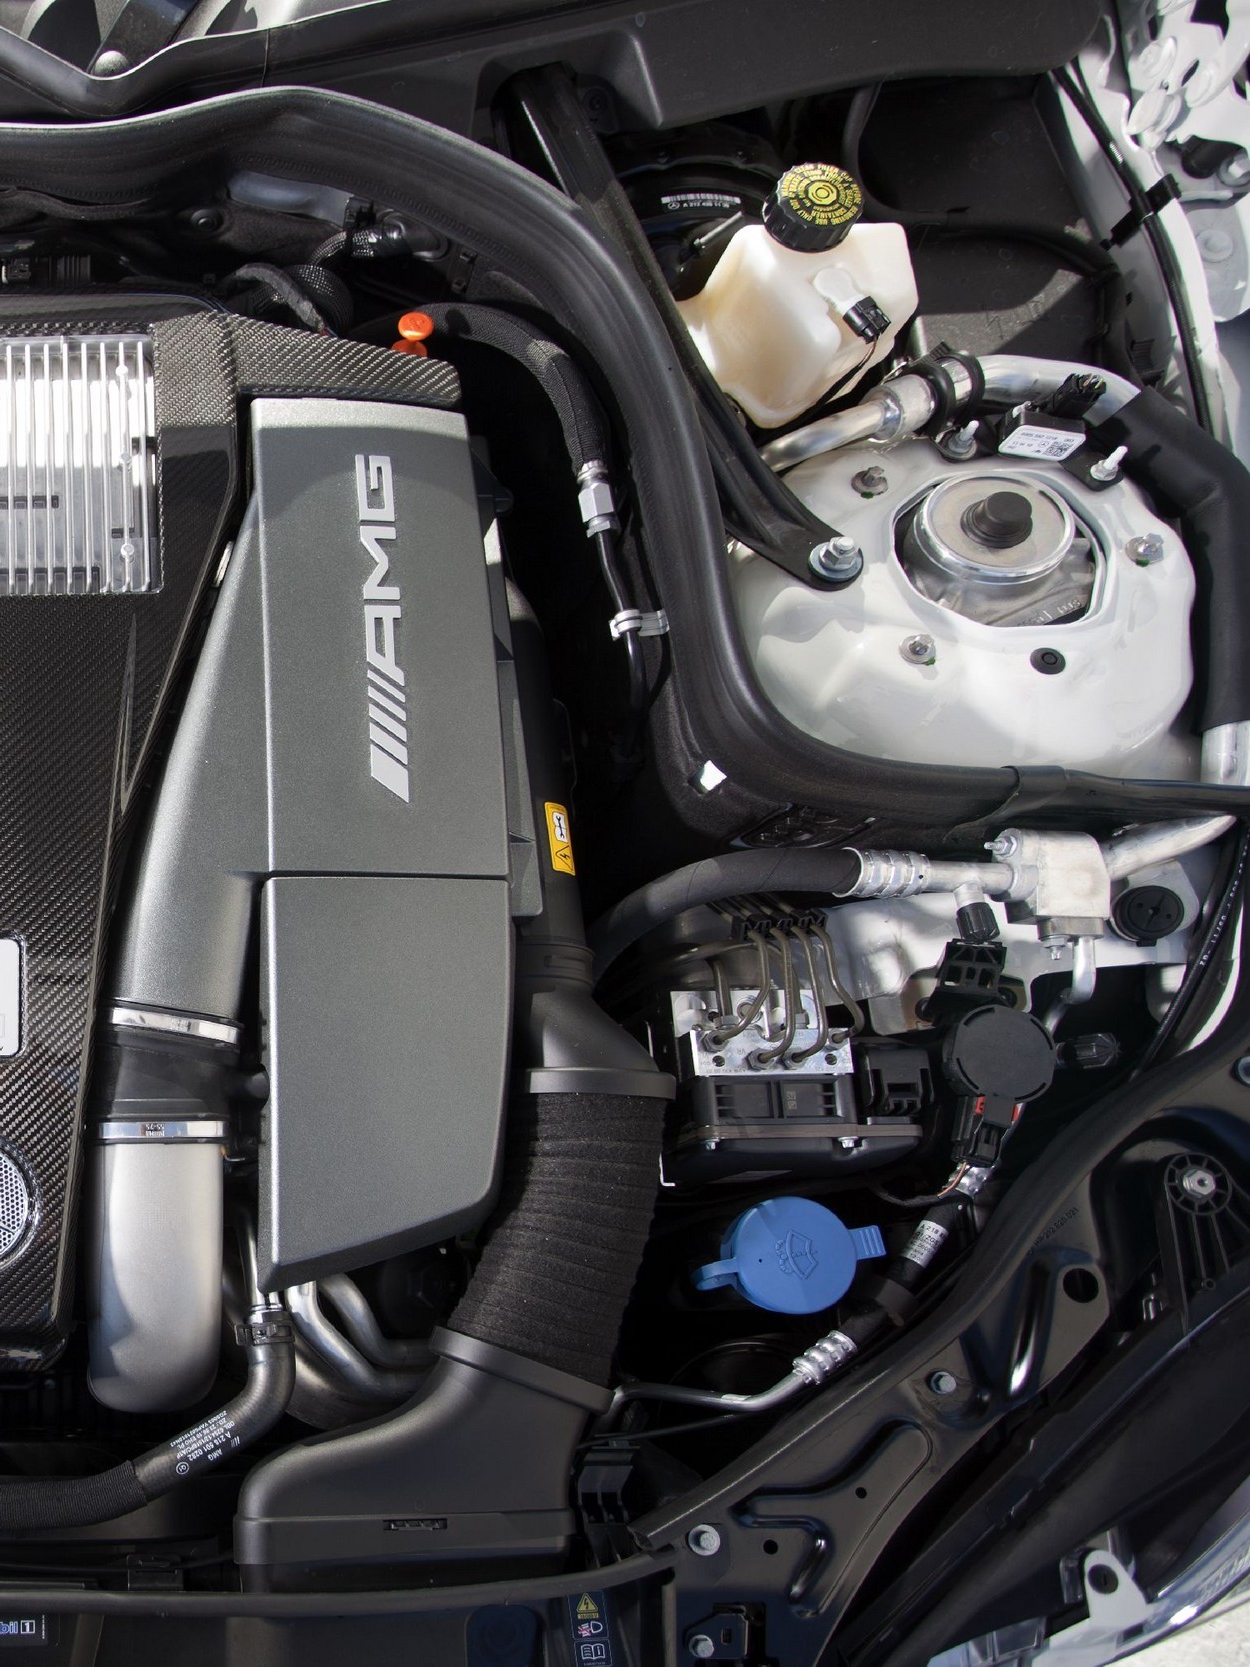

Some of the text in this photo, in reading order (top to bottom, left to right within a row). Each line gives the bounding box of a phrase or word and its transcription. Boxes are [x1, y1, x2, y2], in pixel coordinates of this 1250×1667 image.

[797, 210, 813, 222] ONLY
[355, 454, 405, 687] AMG
[225, 1431, 231, 1439] A
[208, 1448, 223, 1461] AMG
